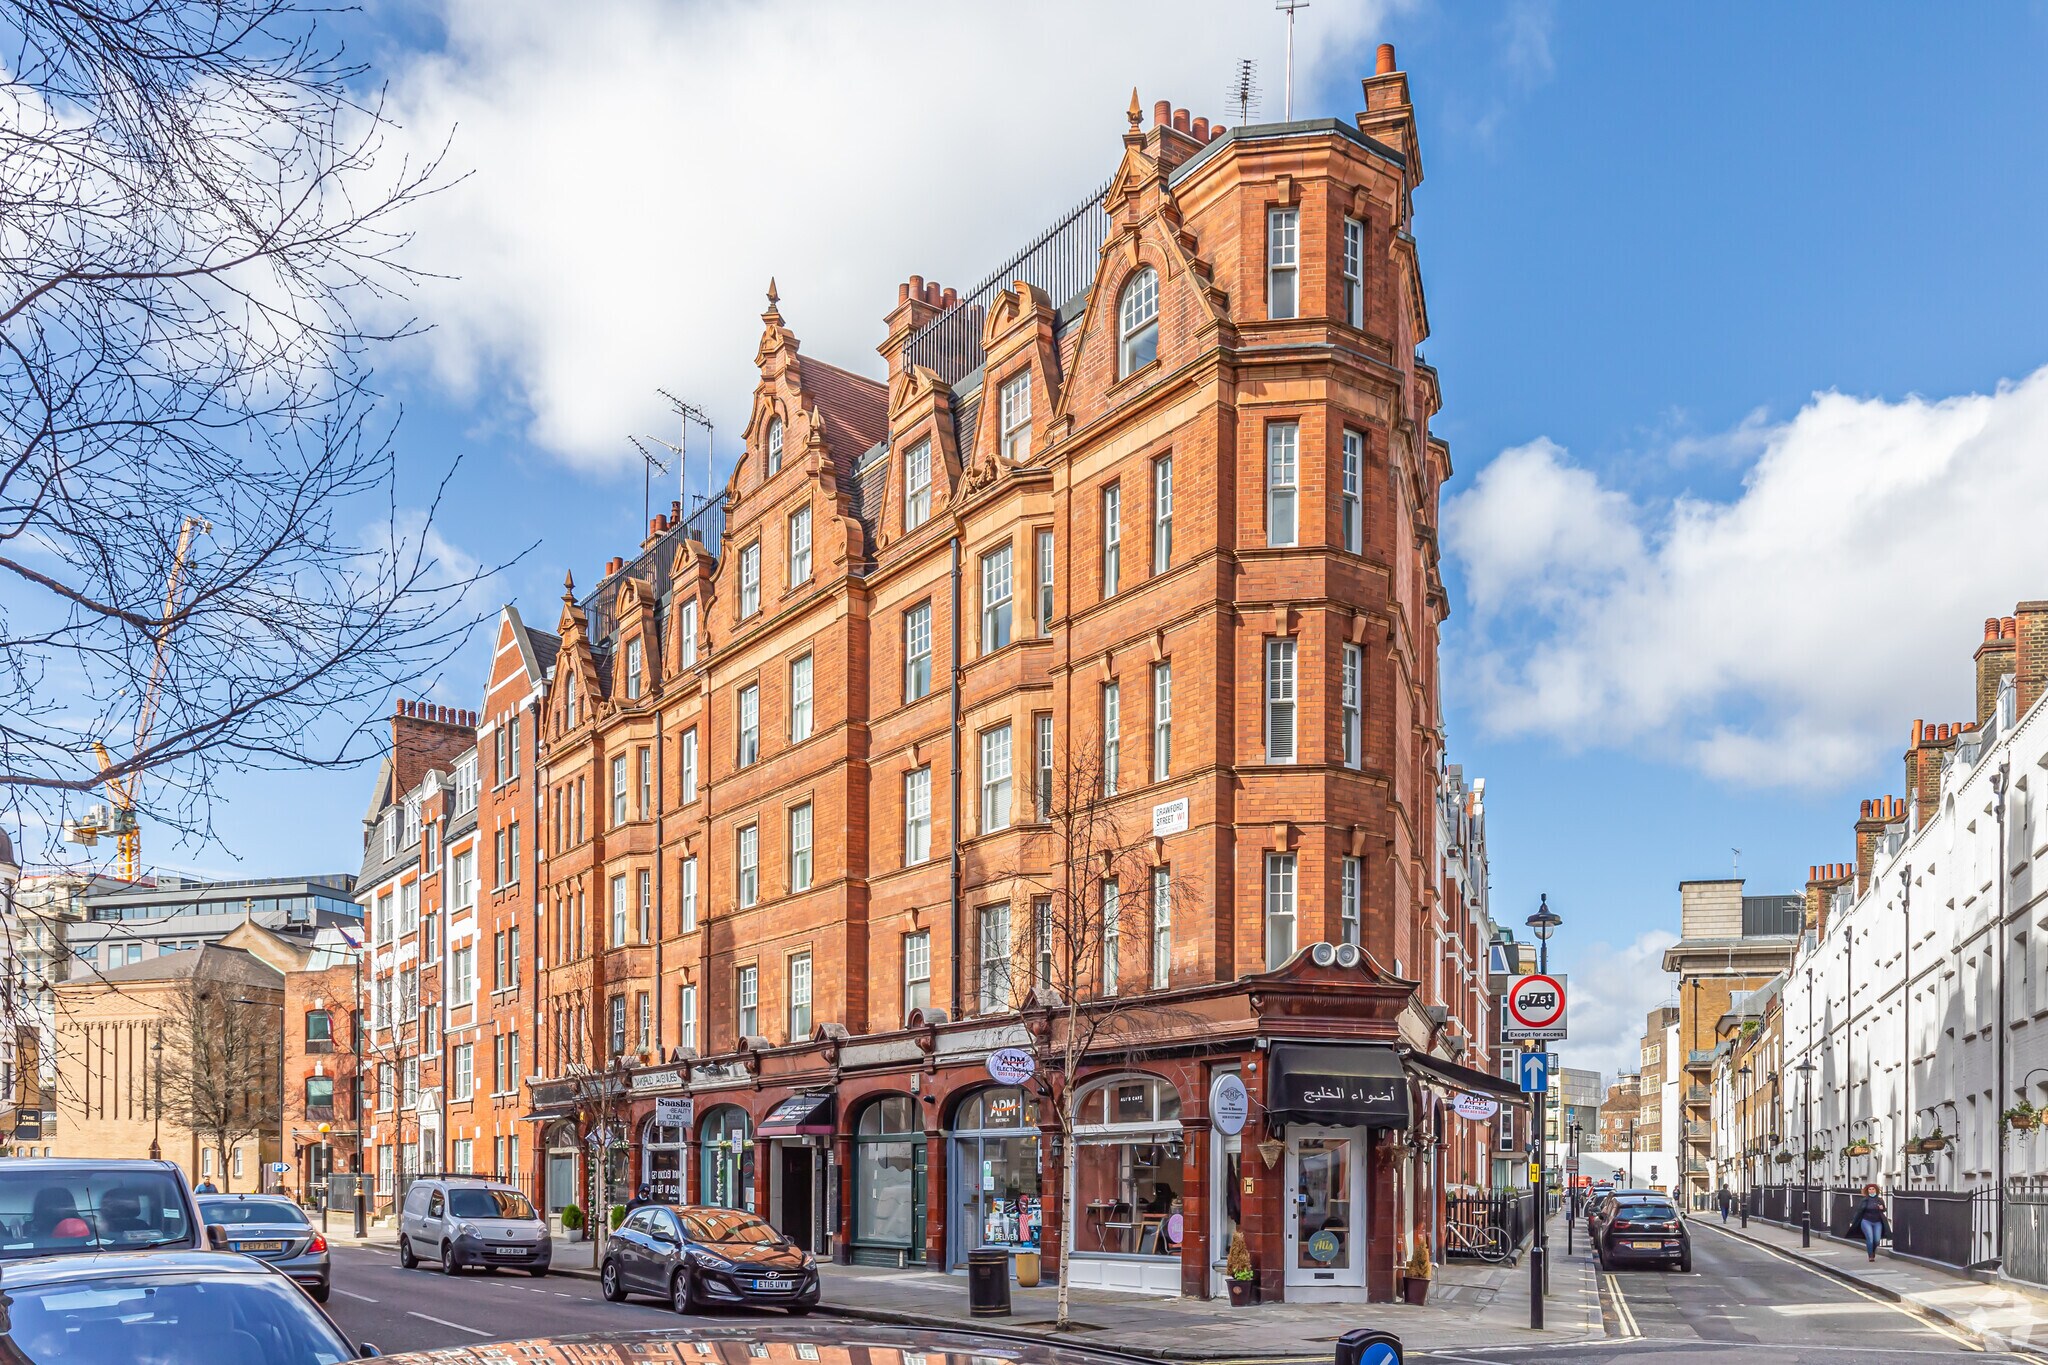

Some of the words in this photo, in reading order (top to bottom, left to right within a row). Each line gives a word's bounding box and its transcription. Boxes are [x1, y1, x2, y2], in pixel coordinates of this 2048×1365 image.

[1156, 802, 1183, 817] CRAWFORD
[1156, 814, 1174, 826] STREET
[1176, 812, 1185, 820] W1
[1303, 1086, 1345, 1104] الخليج
[1351, 1086, 1395, 1104] أضواء
[990, 1099, 1016, 1117] APM
